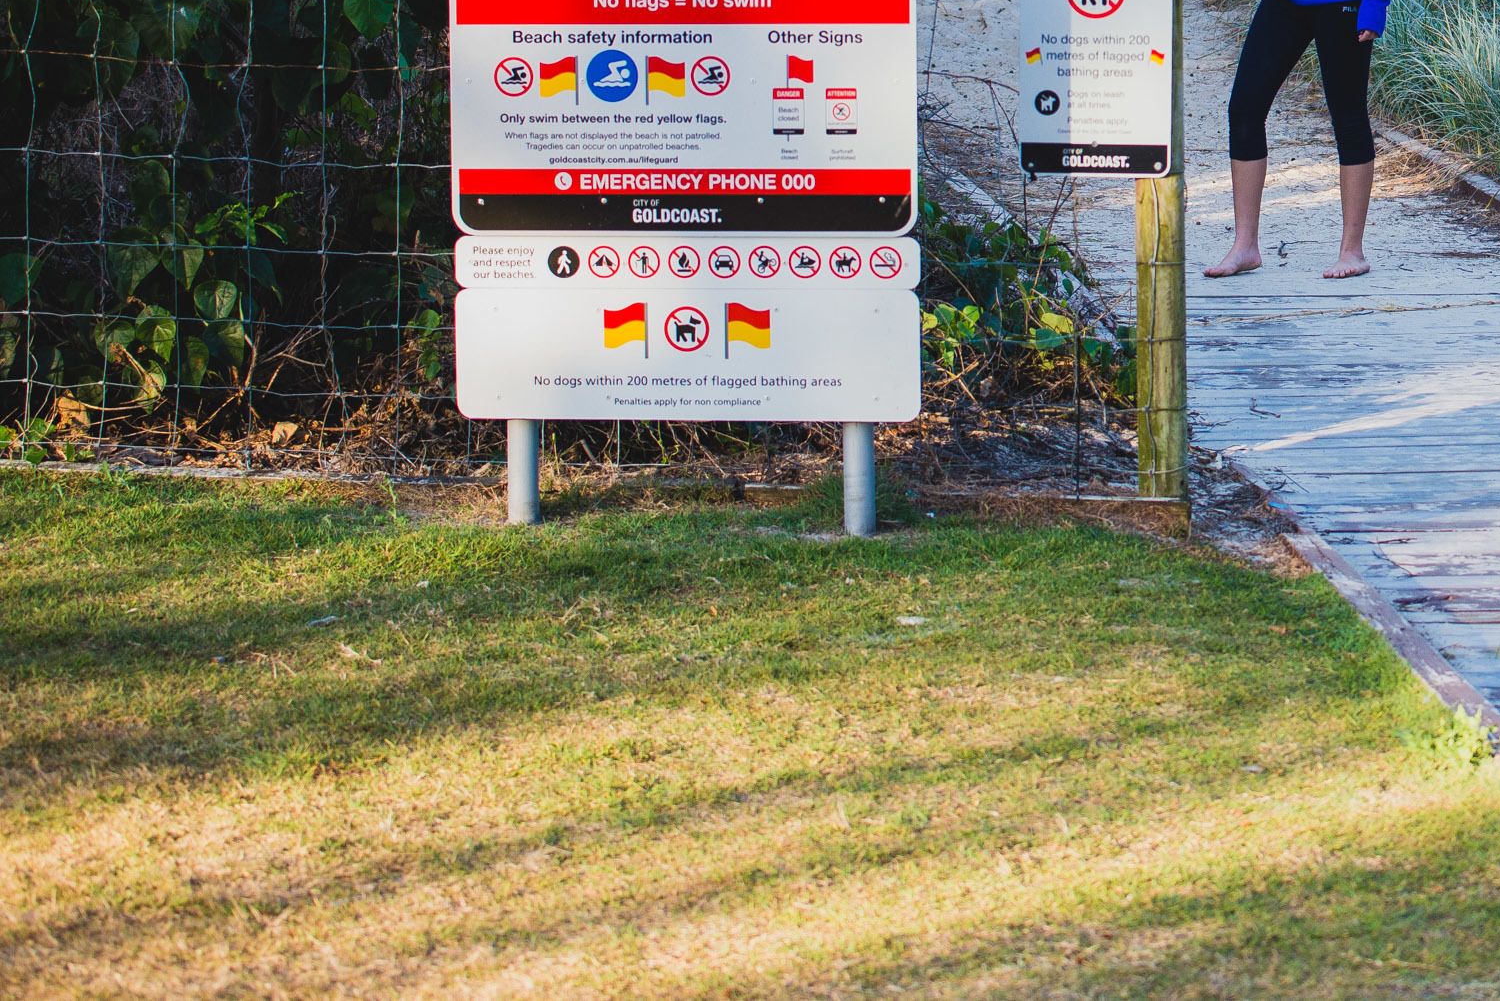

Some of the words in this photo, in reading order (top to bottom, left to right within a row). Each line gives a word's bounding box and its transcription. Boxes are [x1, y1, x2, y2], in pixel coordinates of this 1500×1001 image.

[512, 30, 563, 44] Beach
[568, 30, 616, 46] safety
[621, 30, 713, 44] information
[768, 30, 813, 44] Other
[818, 30, 863, 46] Signs
[1041, 35, 1057, 45] No
[1061, 35, 1089, 47] dogs
[1093, 35, 1125, 45] within
[1129, 35, 1150, 45] 200
[1046, 51, 1084, 61] metres
[1088, 51, 1099, 61] of
[1103, 51, 1144, 63] flagged
[1057, 67, 1099, 79] bathing
[1103, 69, 1133, 78] areas
[500, 114, 525, 126] Only
[529, 114, 558, 123] swim
[562, 114, 610, 123] between
[614, 114, 631, 123] the
[635, 114, 653, 123] red
[657, 114, 692, 126] yellow
[696, 114, 727, 126] flags.
[505, 132, 527, 140] When
[530, 132, 548, 141] flags
[551, 132, 563, 140] are
[565, 132, 578, 140] not
[580, 132, 618, 141] displayed
[620, 132, 633, 140] the
[635, 132, 659, 140] beach
[662, 132, 668, 140] is
[670, 132, 683, 140] not
[686, 132, 722, 141] patrolled.
[526, 142, 564, 151] Tragedies
[619, 142, 663, 151] unpatrolled
[666, 142, 701, 150] beaches.
[549, 155, 679, 165] goldcoastcity.com.au/lifeguard
[580, 173, 704, 190] EMERGENCY
[708, 173, 777, 190] PHONE
[781, 173, 816, 190] 000
[633, 199, 648, 207] CITY
[650, 199, 660, 207] OF
[473, 246, 503, 255] Please
[507, 246, 535, 256] enjoy
[473, 259, 492, 267] and
[496, 260, 531, 268] respect
[494, 270, 536, 279] beaches.
[534, 375, 550, 386] No
[554, 375, 582, 388] dogs
[585, 375, 623, 386] within
[627, 375, 648, 386] 200
[651, 375, 692, 386] metres
[695, 375, 708, 386] of
[711, 375, 757, 389] flagged
[761, 375, 807, 389] bathing
[811, 377, 842, 387] areas
[614, 397, 651, 406] Penalties
[654, 397, 677, 407] apply
[680, 397, 692, 406] for
[713, 397, 761, 407] compliance
